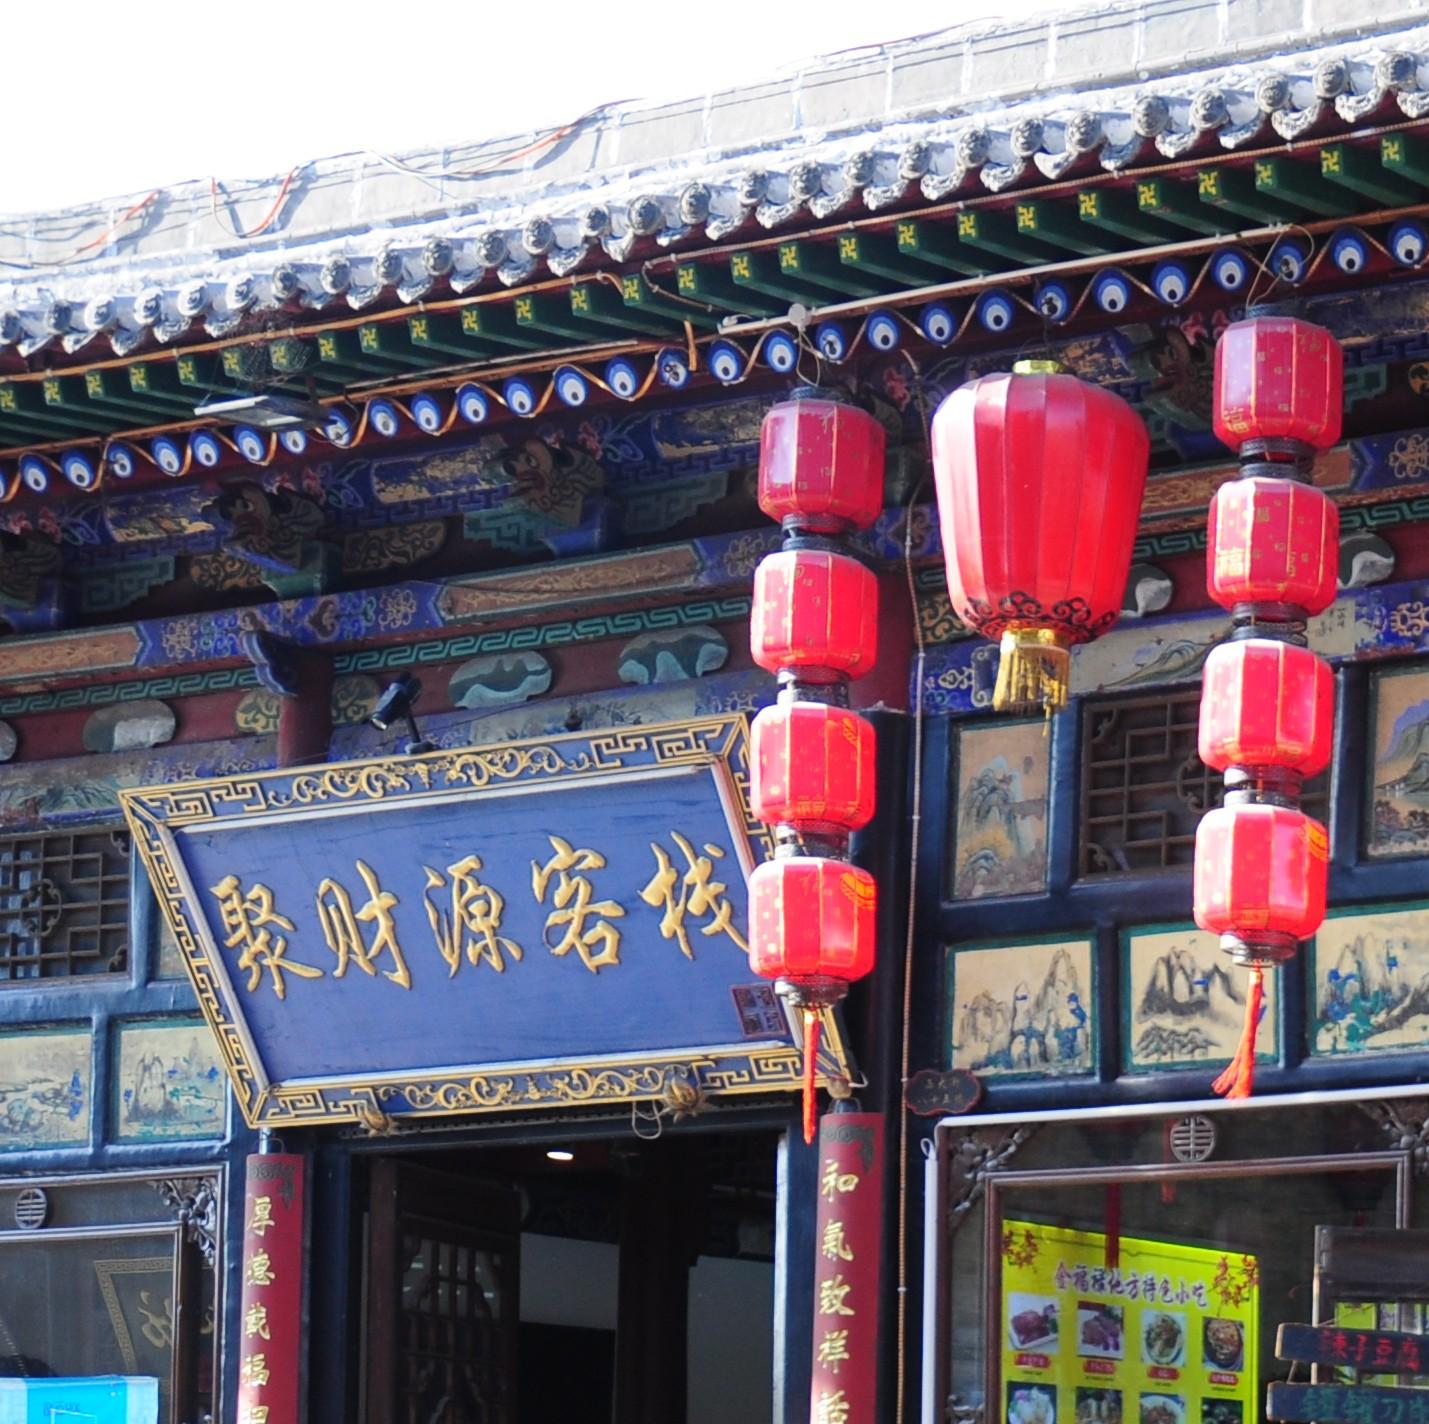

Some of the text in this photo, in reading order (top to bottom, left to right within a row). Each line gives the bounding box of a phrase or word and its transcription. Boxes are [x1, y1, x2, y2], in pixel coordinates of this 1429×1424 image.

[210, 830, 750, 1000] 聚财源客栈
